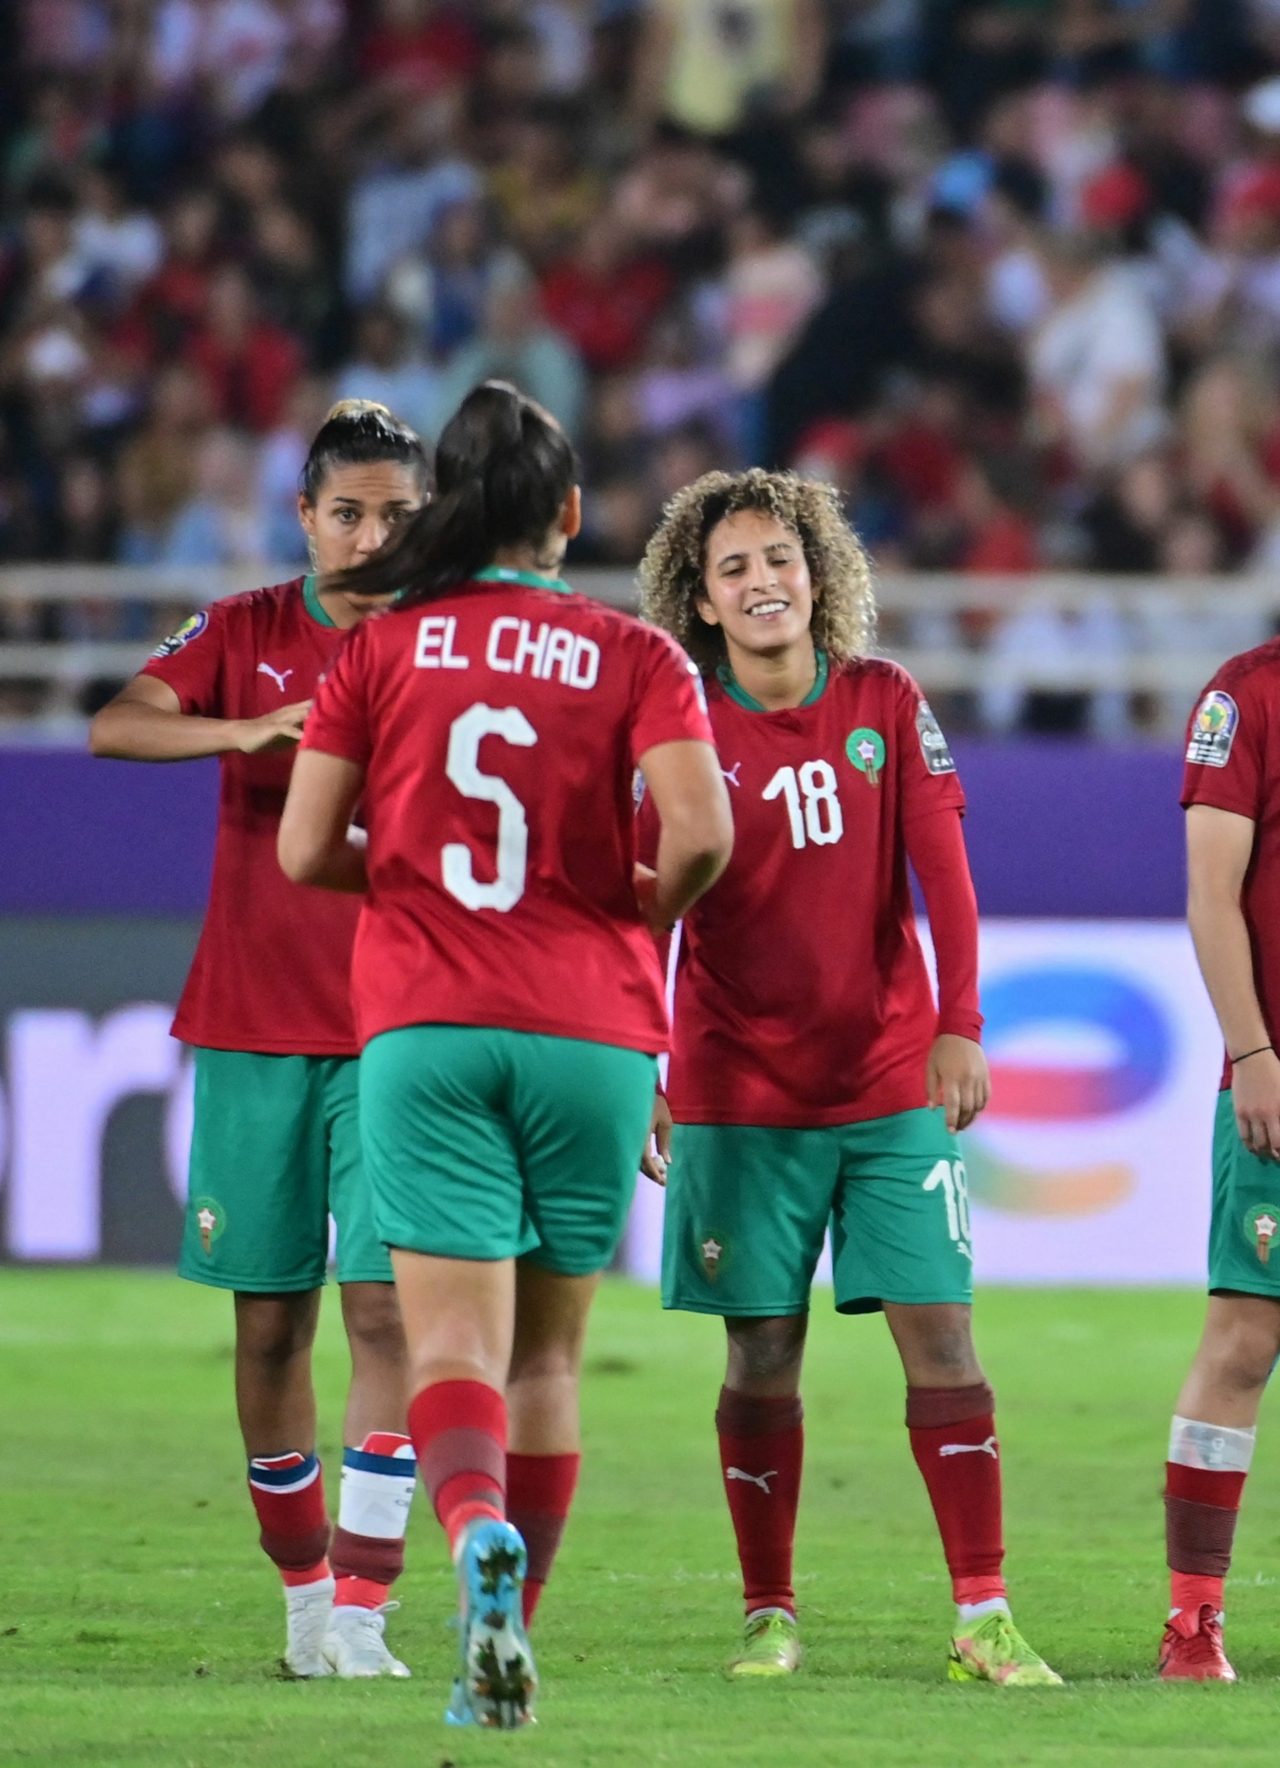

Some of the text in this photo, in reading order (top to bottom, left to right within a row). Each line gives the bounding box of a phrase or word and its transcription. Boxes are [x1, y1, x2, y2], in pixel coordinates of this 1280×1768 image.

[413, 616, 600, 690] EL CHAD
[761, 759, 844, 849] 18
